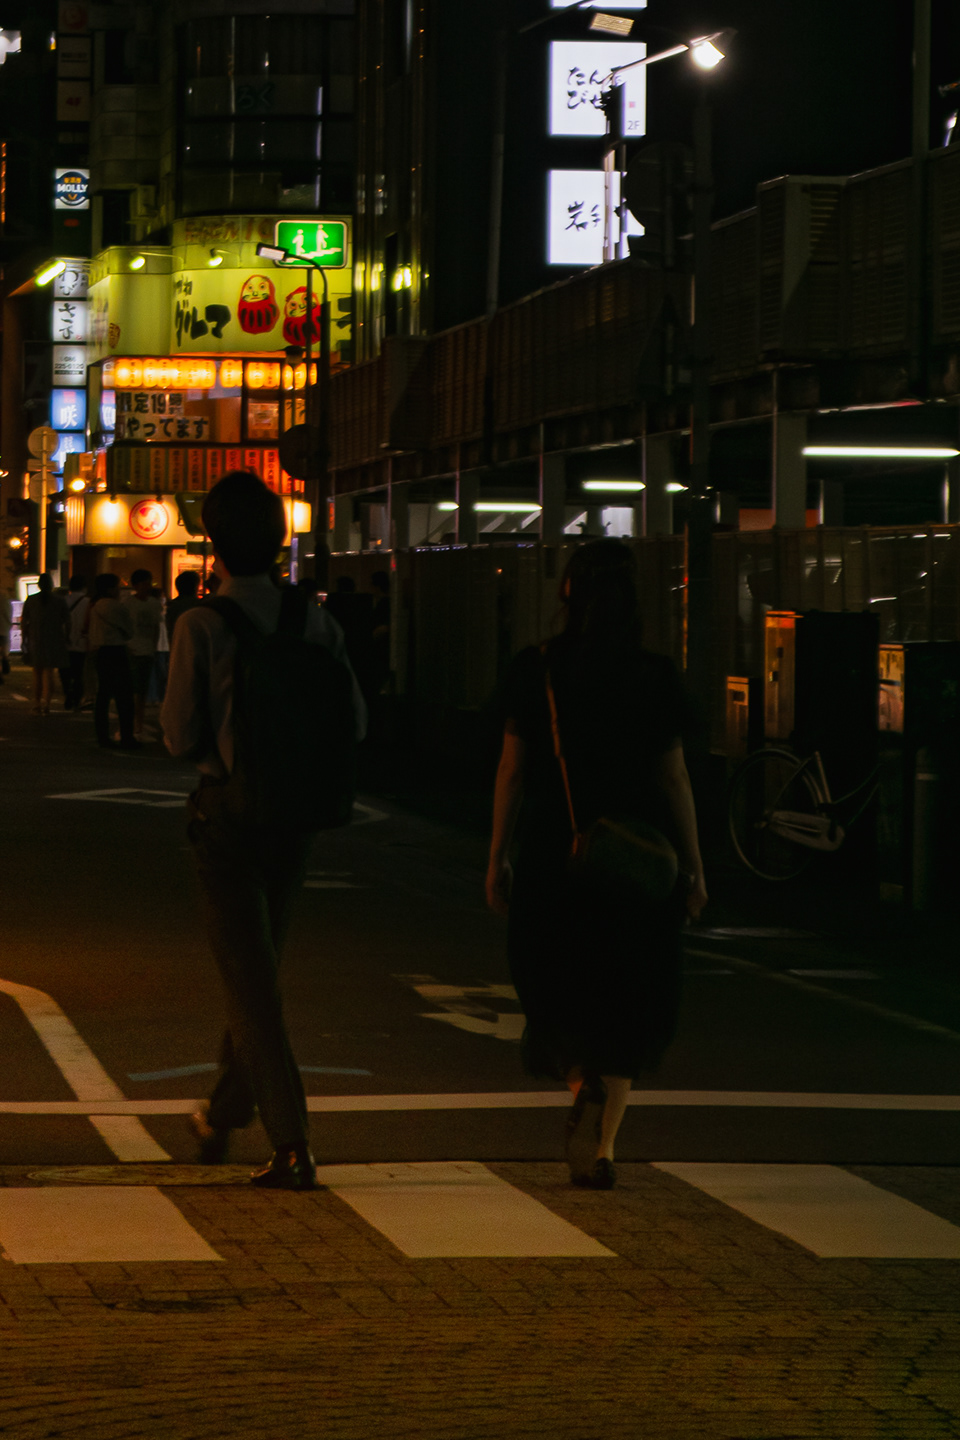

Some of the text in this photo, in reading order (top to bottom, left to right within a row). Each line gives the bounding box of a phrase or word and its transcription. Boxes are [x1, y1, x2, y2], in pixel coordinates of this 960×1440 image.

[627, 120, 640, 130] 2F
[60, 404, 78, 429] 咲
[127, 416, 208, 439] やってます
